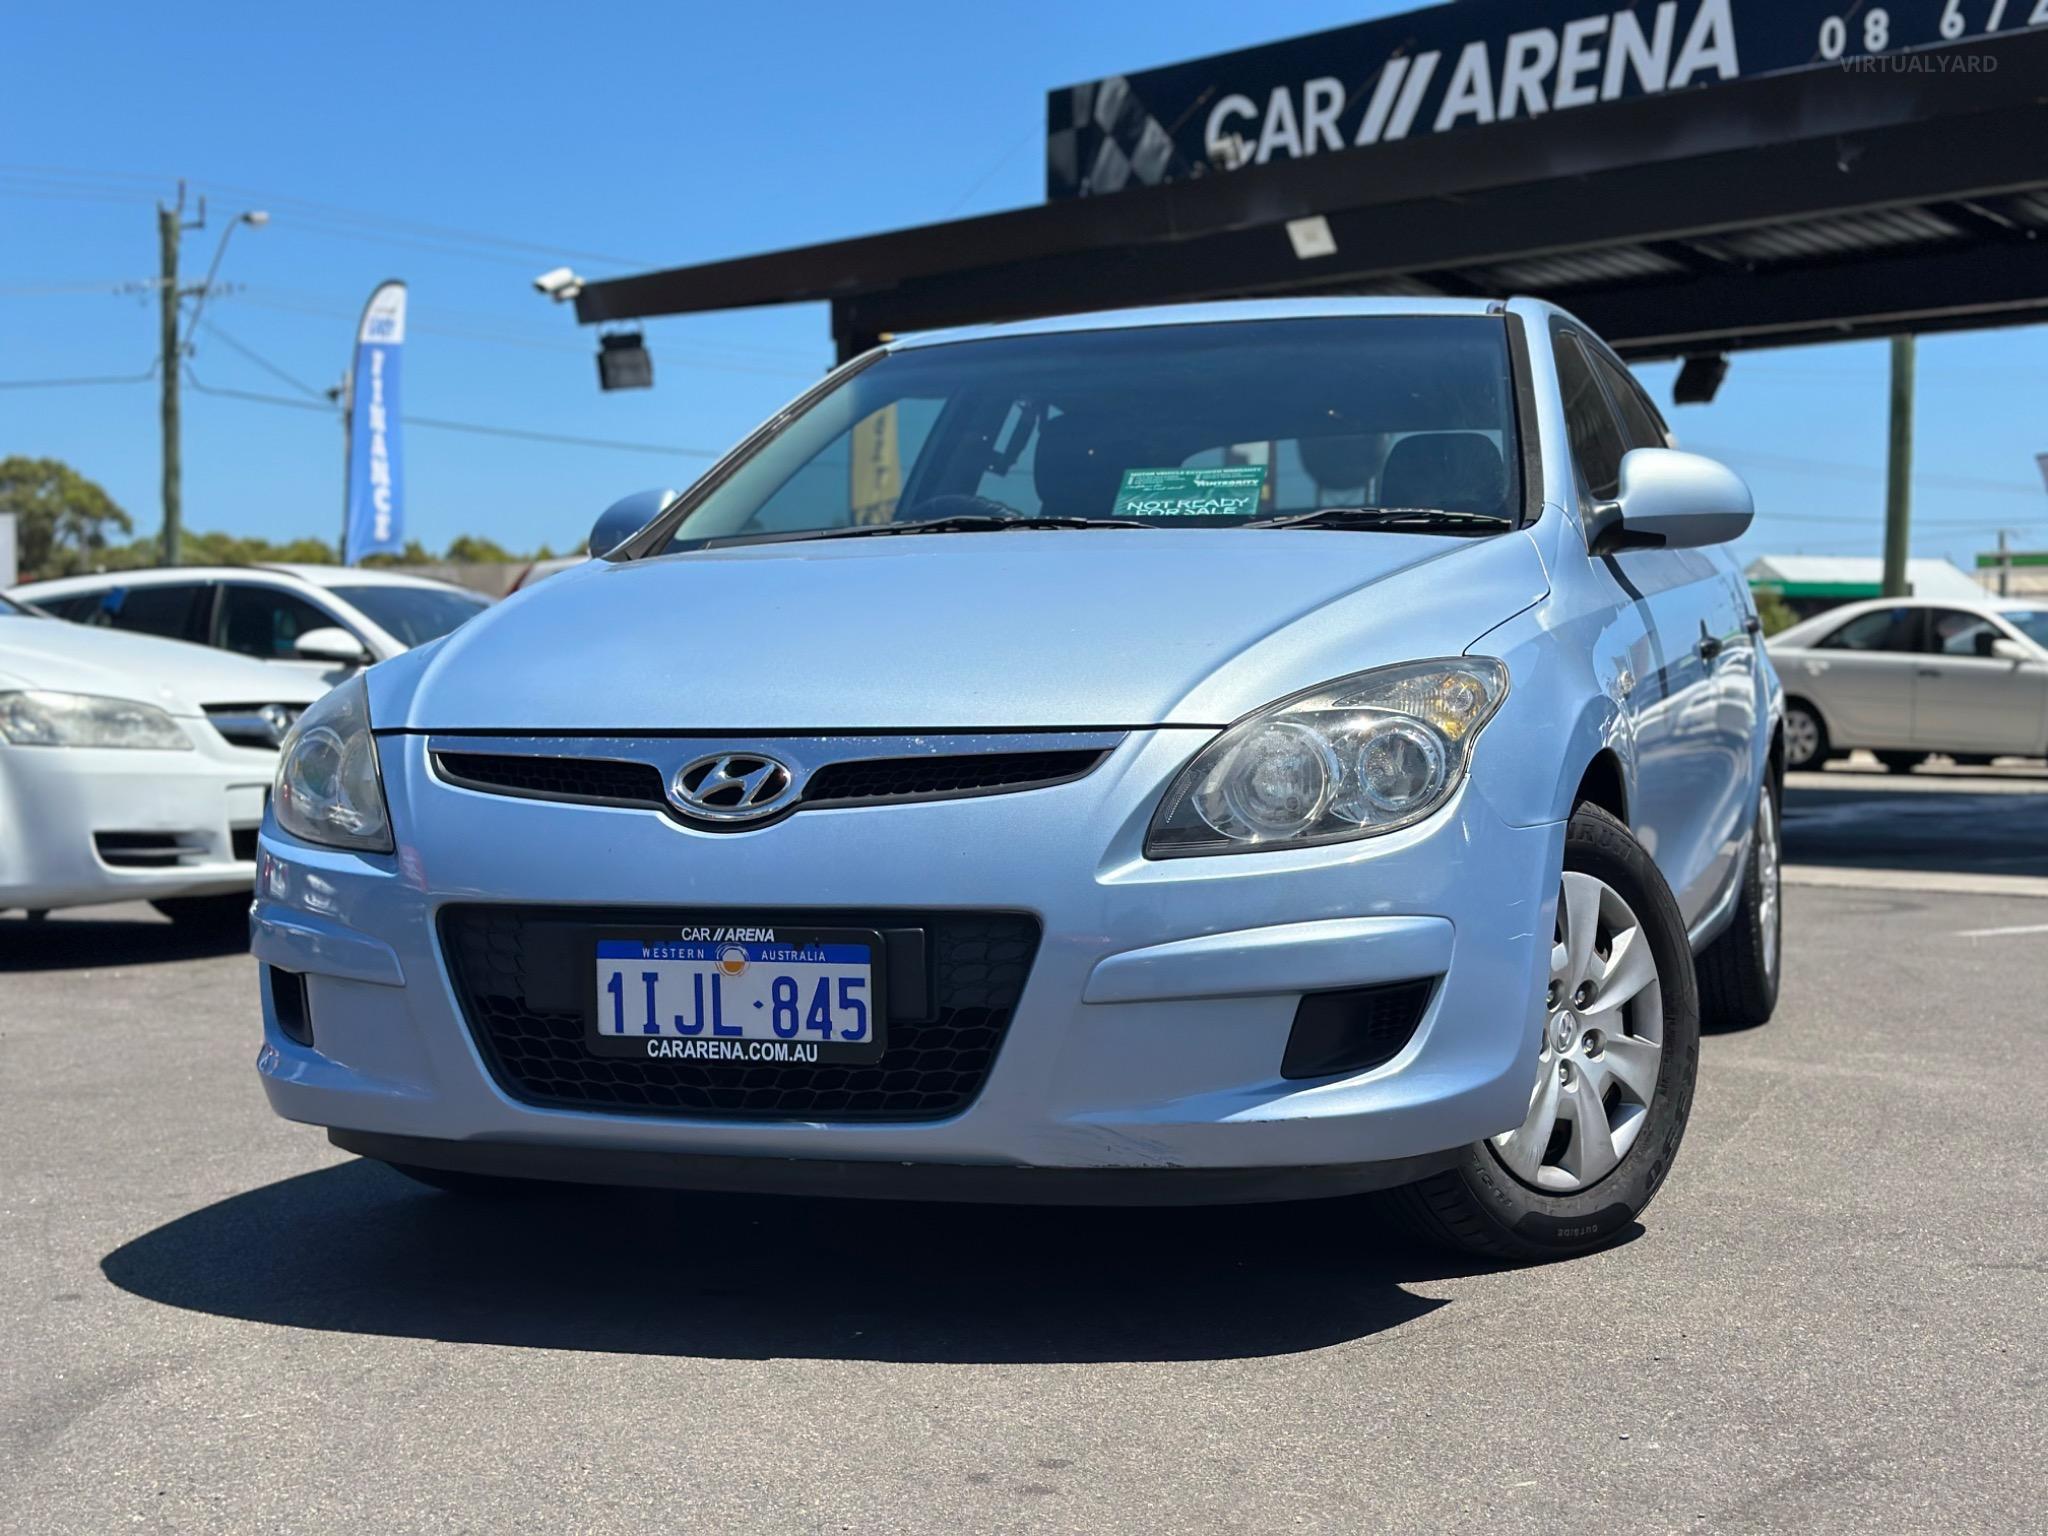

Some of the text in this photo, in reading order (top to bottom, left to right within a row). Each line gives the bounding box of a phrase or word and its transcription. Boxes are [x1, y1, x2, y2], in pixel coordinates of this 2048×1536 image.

[1819, 8, 1889, 60] 08
[1206, 0, 1739, 170] CAR ARENA
[1127, 497, 1249, 511] NOT READY
[1136, 506, 1238, 516] FOR SALE
[681, 928, 775, 942] CAR ARENA
[642, 948, 826, 962] WESTERN AUSTRALIA
[607, 972, 867, 1041] 1IJL 845
[647, 1039, 818, 1062] CARARENA.COM.AU
